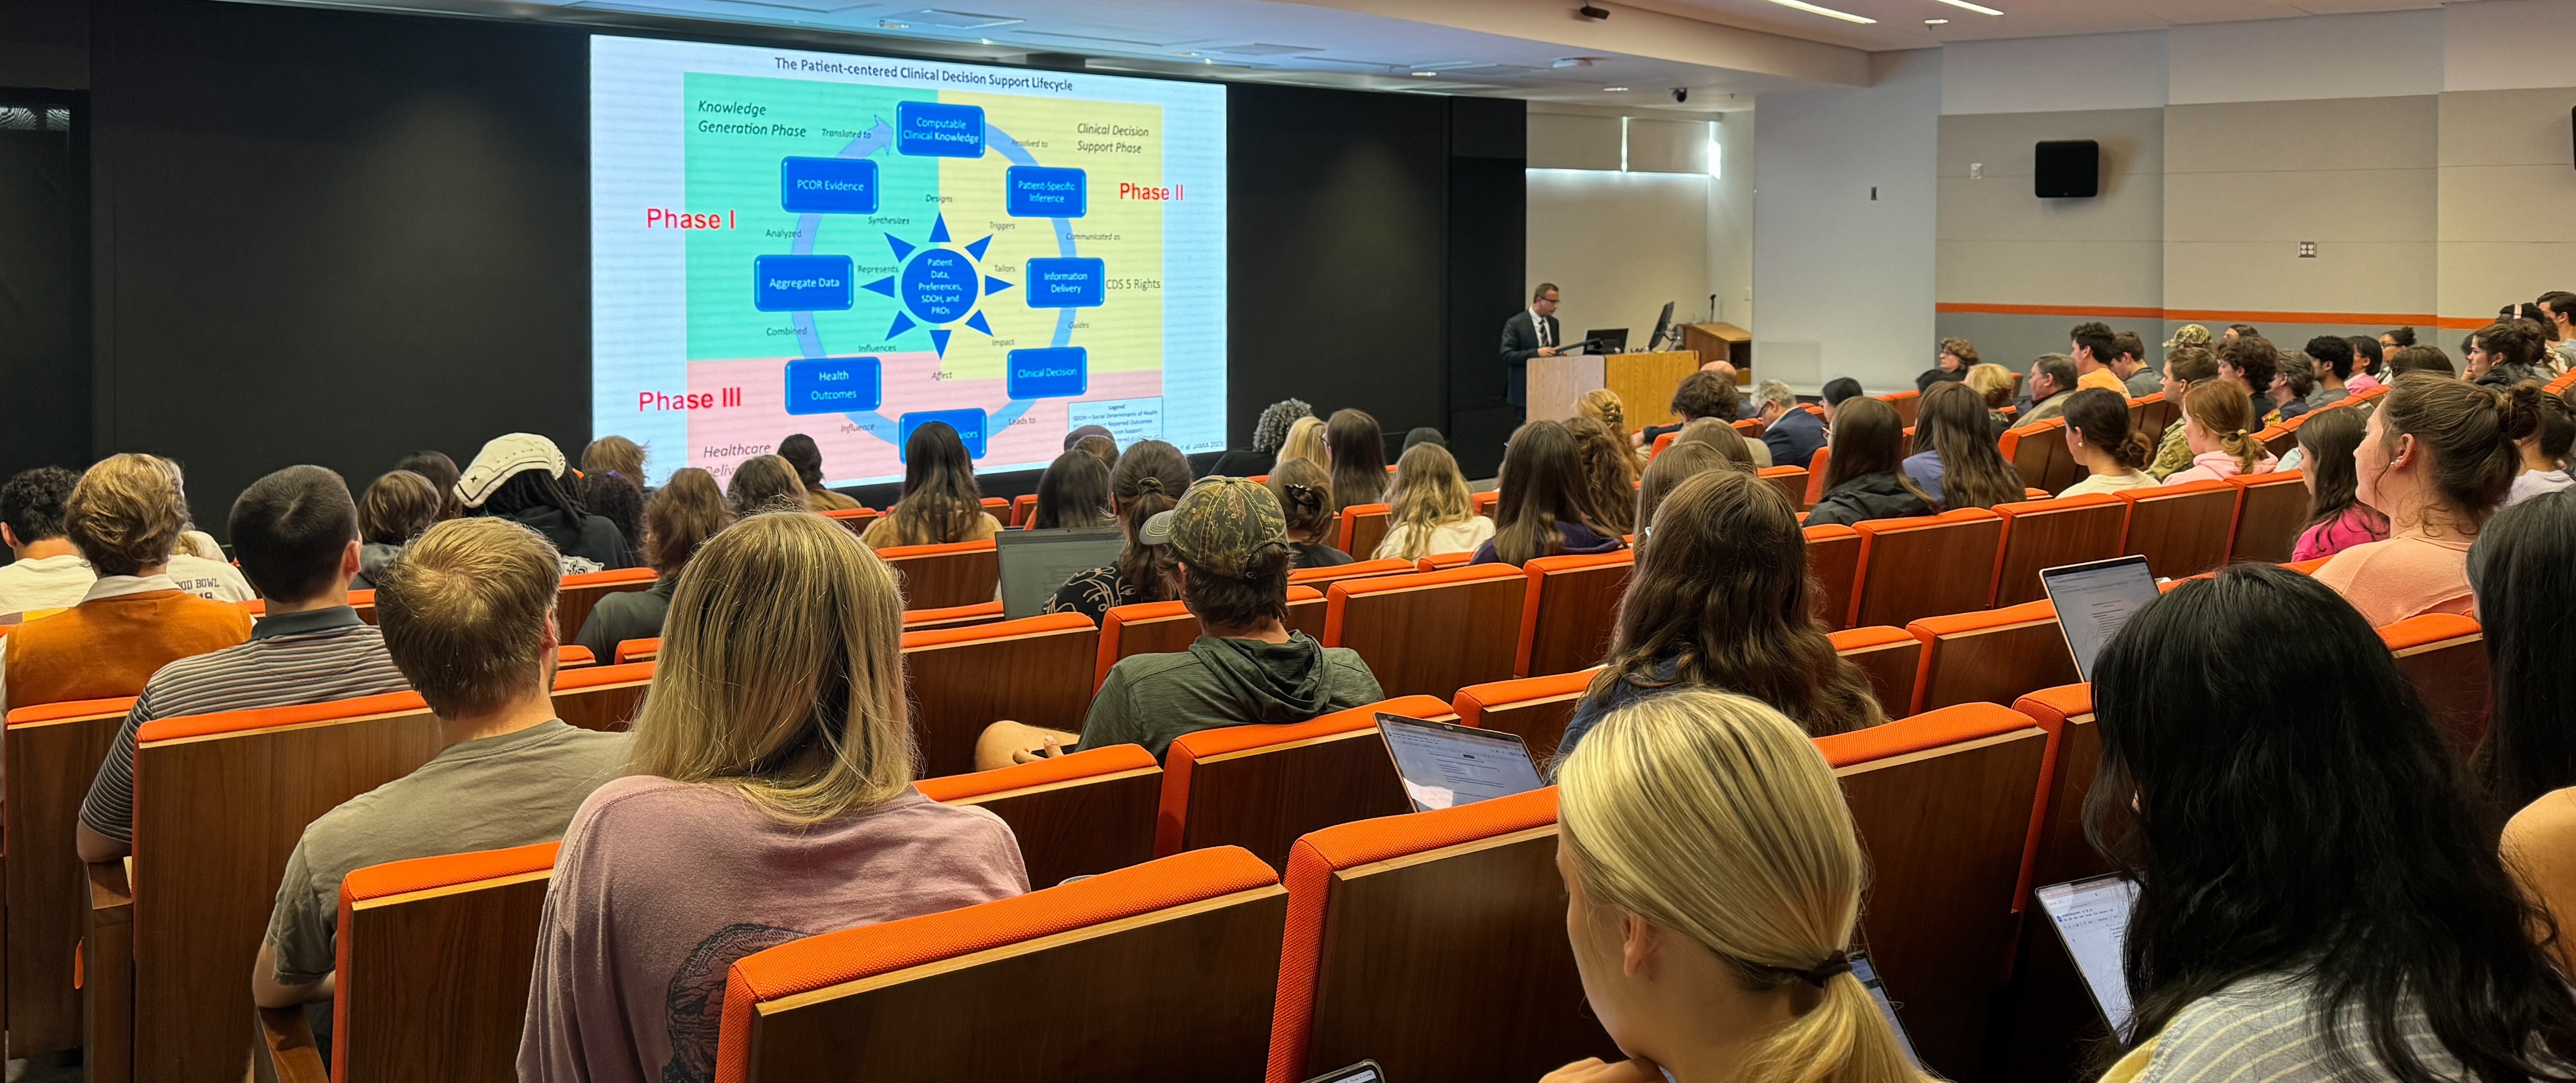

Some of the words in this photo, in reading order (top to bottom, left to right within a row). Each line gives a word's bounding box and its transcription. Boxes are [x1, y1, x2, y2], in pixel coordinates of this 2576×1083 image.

[775, 57, 797, 70] The
[801, 59, 897, 78] Patient-centered
[900, 67, 938, 81] Clinical
[942, 70, 986, 84] Decision
[989, 74, 1029, 89] Support
[1032, 77, 1072, 92] Lifecycle
[699, 100, 766, 117] Knowledge
[916, 117, 966, 130] Computable
[699, 120, 767, 135] Generation
[771, 124, 806, 138] Phase
[822, 128, 861, 139] Translated
[863, 130, 871, 139] to
[1078, 123, 1110, 135] Clinical
[1112, 126, 1149, 138] Decision
[903, 130, 932, 140] Clinical
[934, 132, 979, 144] Knowledge
[1077, 140, 1113, 153] Support
[1116, 142, 1142, 154] Phase
[797, 180, 822, 190] PCOR
[825, 181, 864, 191] Evidence
[1018, 181, 1075, 192] Patient-Specific
[1119, 183, 1170, 201] Phase
[1176, 185, 1184, 201] II
[926, 194, 953, 204] Designs
[1029, 193, 1065, 203] Inference
[647, 208, 720, 229] Phase
[730, 210, 735, 229] I
[868, 216, 910, 226] Synthesizes
[990, 221, 1015, 231] Triggers
[766, 229, 802, 239] Analyzed
[927, 258, 952, 267] Patient
[858, 265, 899, 275] Represents
[931, 271, 950, 280] Data,
[1044, 271, 1088, 281] Information
[769, 278, 816, 290] Aggregate
[819, 278, 840, 288] Data
[918, 282, 962, 292] Preferences,
[1051, 283, 1082, 295] Delivery
[1107, 279, 1123, 290] CDS
[1126, 279, 1131, 289] 5
[1134, 279, 1160, 291] Rights
[946, 294, 959, 302] and
[1068, 321, 1089, 329] Guides
[766, 327, 808, 337] Combined
[992, 338, 1014, 347] Impact
[858, 344, 897, 353] Influences
[819, 371, 849, 381] Health
[931, 371, 952, 381] Affect
[1018, 367, 1044, 378] Clinical
[1046, 367, 1077, 377] Decision
[639, 391, 713, 412] Phase
[723, 387, 741, 407] III
[811, 390, 857, 400] Outcomes
[840, 423, 875, 433] Influence
[704, 444, 771, 459] Healthcare
[705, 464, 735, 477] Deliv
[195, 578, 219, 588] BOWL
